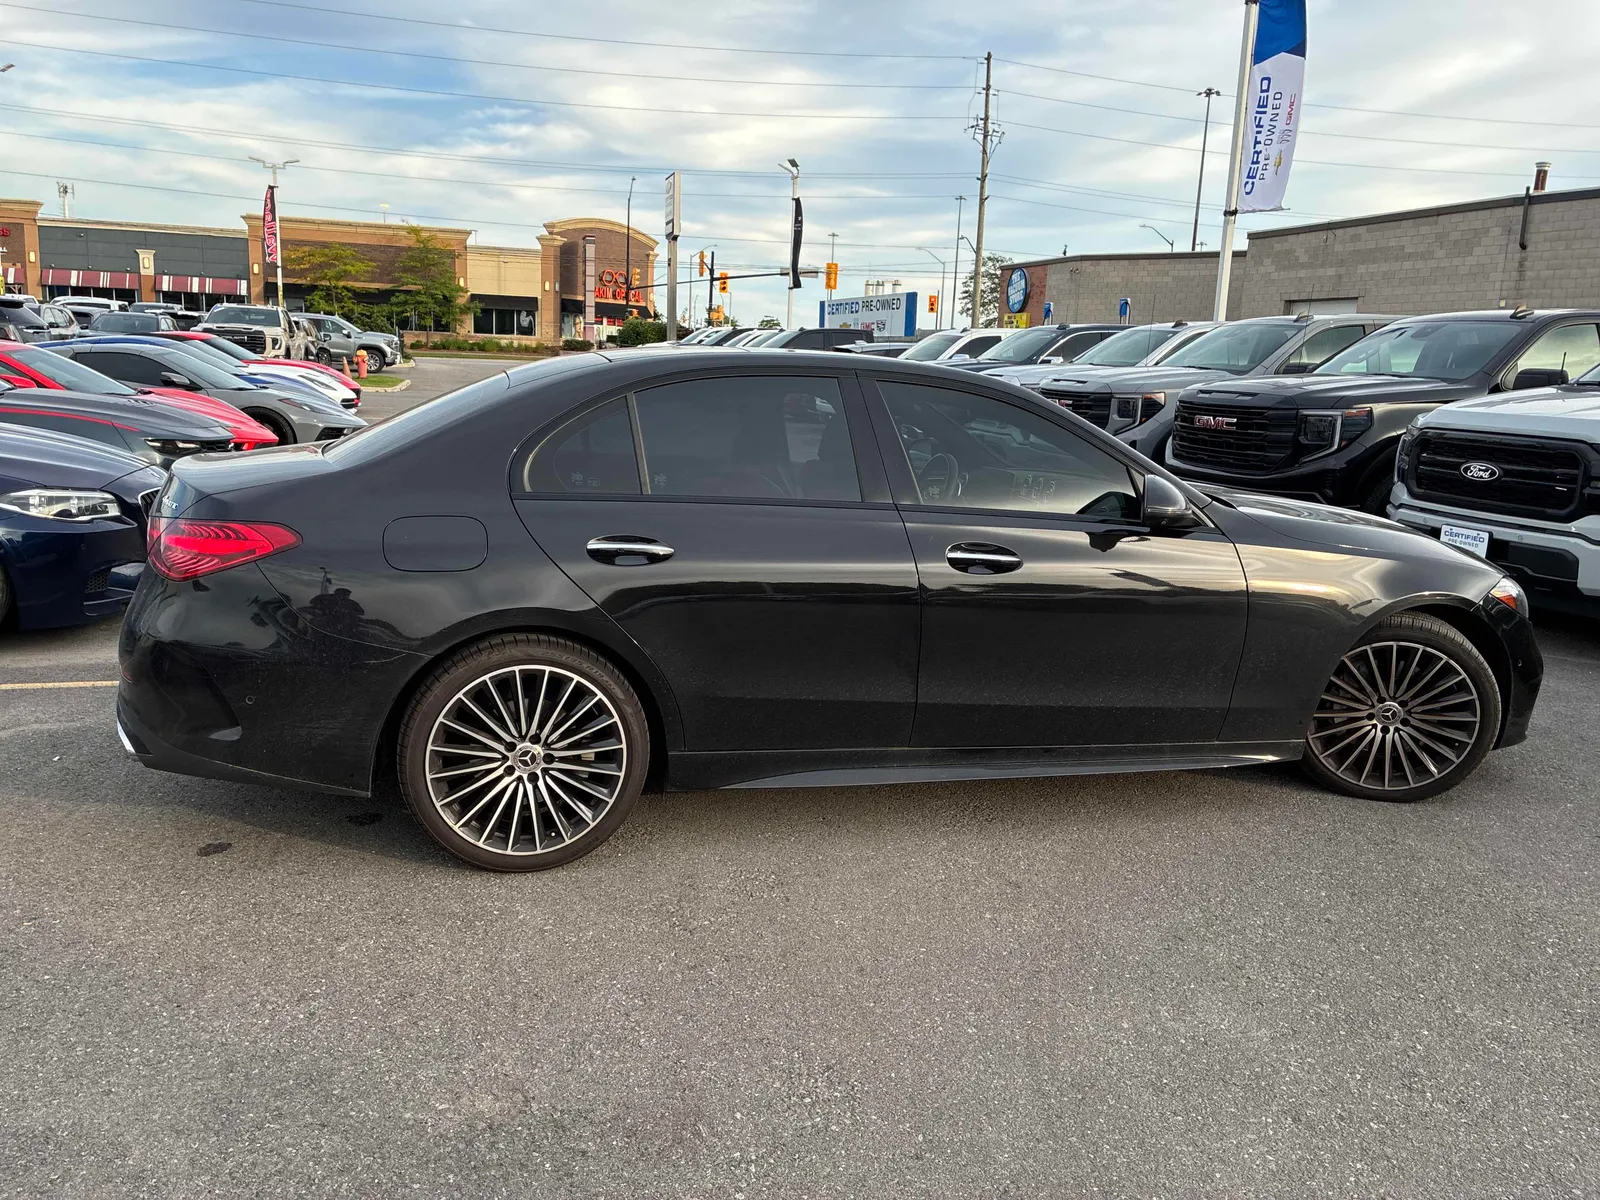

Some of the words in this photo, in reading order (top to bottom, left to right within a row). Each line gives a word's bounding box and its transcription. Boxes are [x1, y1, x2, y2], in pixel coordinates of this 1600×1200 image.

[1285, 93, 1296, 126] GMC
[1244, 76, 1272, 195] CERTIFIED
[1258, 91, 1283, 180] PRE-OWNED
[594, 286, 613, 299] AKIM
[615, 288, 644, 302] OPICAL
[827, 301, 859, 315] CERTIFIED
[861, 298, 902, 312] PRE-OWNED
[1194, 415, 1237, 430] GMC
[1467, 464, 1491, 478] Ford
[1444, 530, 1485, 543] CERTIFIED
